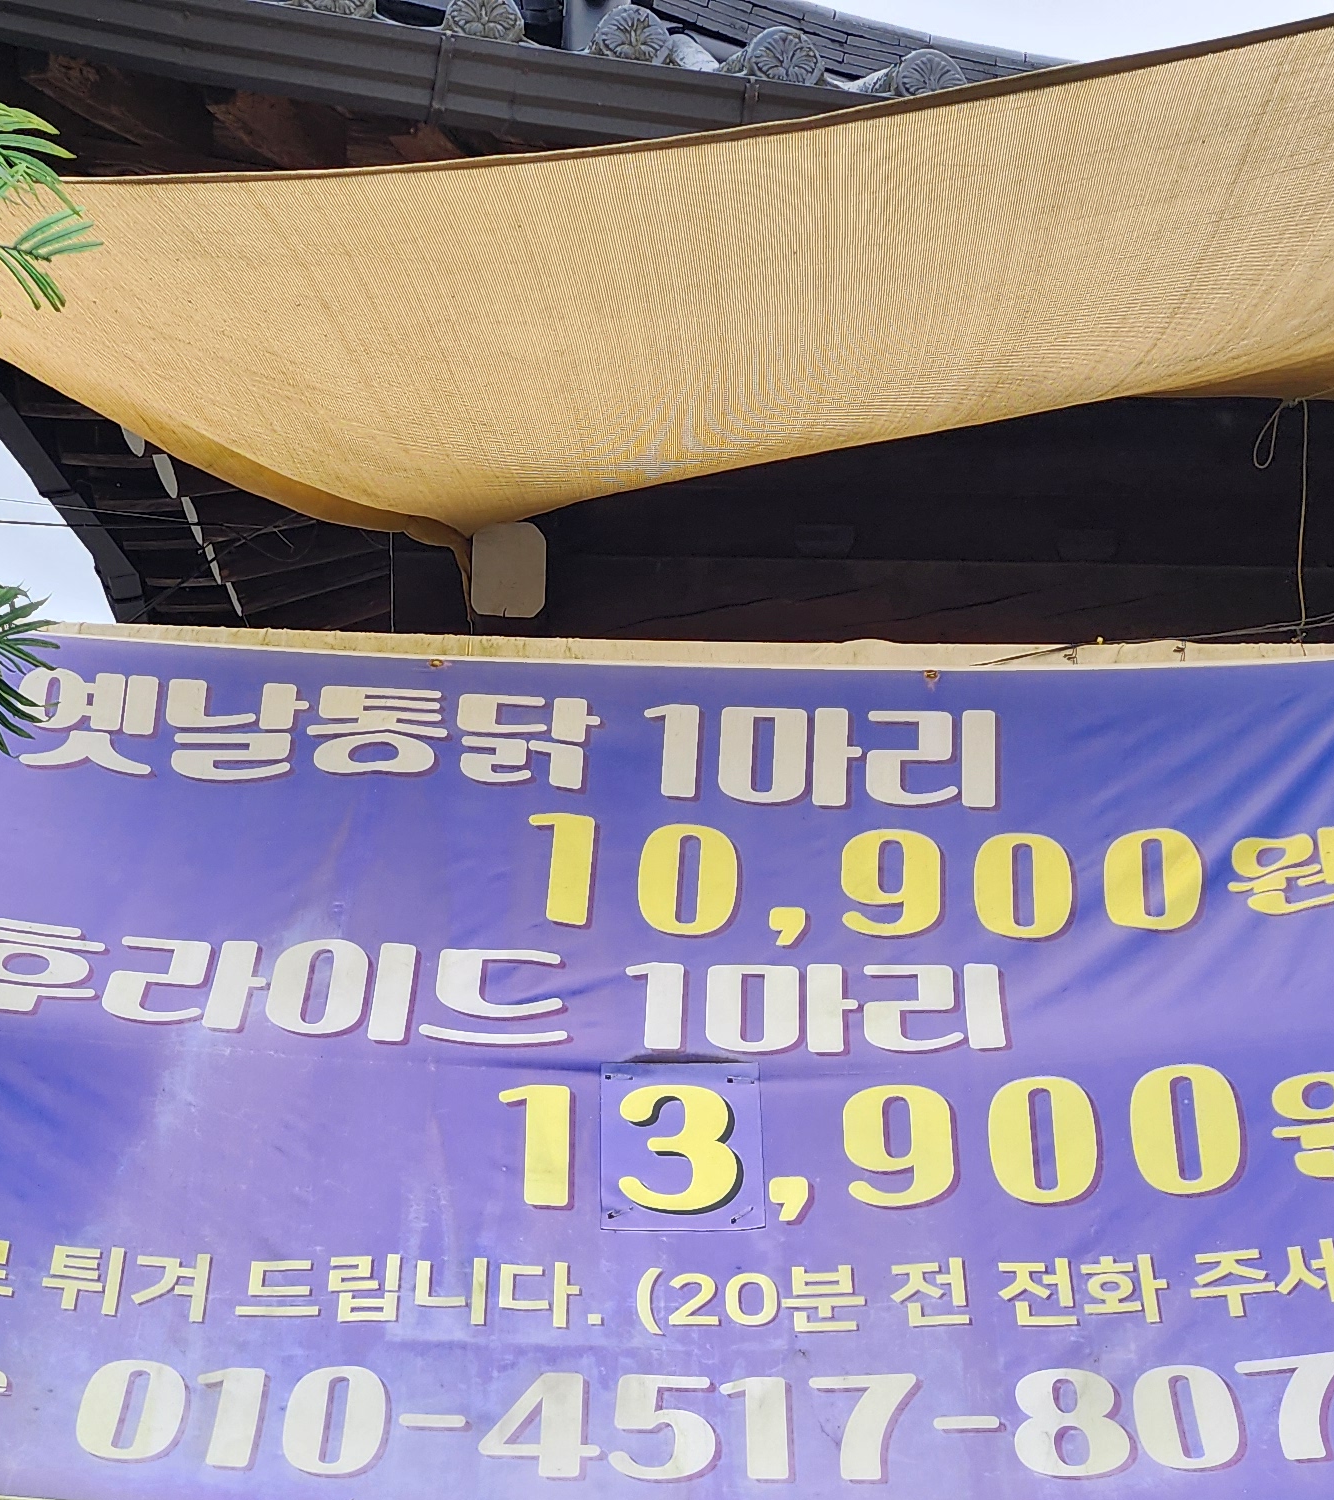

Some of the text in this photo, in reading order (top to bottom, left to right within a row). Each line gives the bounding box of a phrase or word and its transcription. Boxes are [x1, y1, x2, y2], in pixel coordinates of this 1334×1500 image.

[17, 667, 1000, 809] 옛날통닭 1마리
[625, 962, 1010, 1055] 1마리
[40, 1244, 213, 1325] 튀겨
[234, 1252, 605, 1331] 드립니다.
[635, 1262, 868, 1335] (20분
[888, 1258, 976, 1328] 전
[995, 1253, 1171, 1330] 전화
